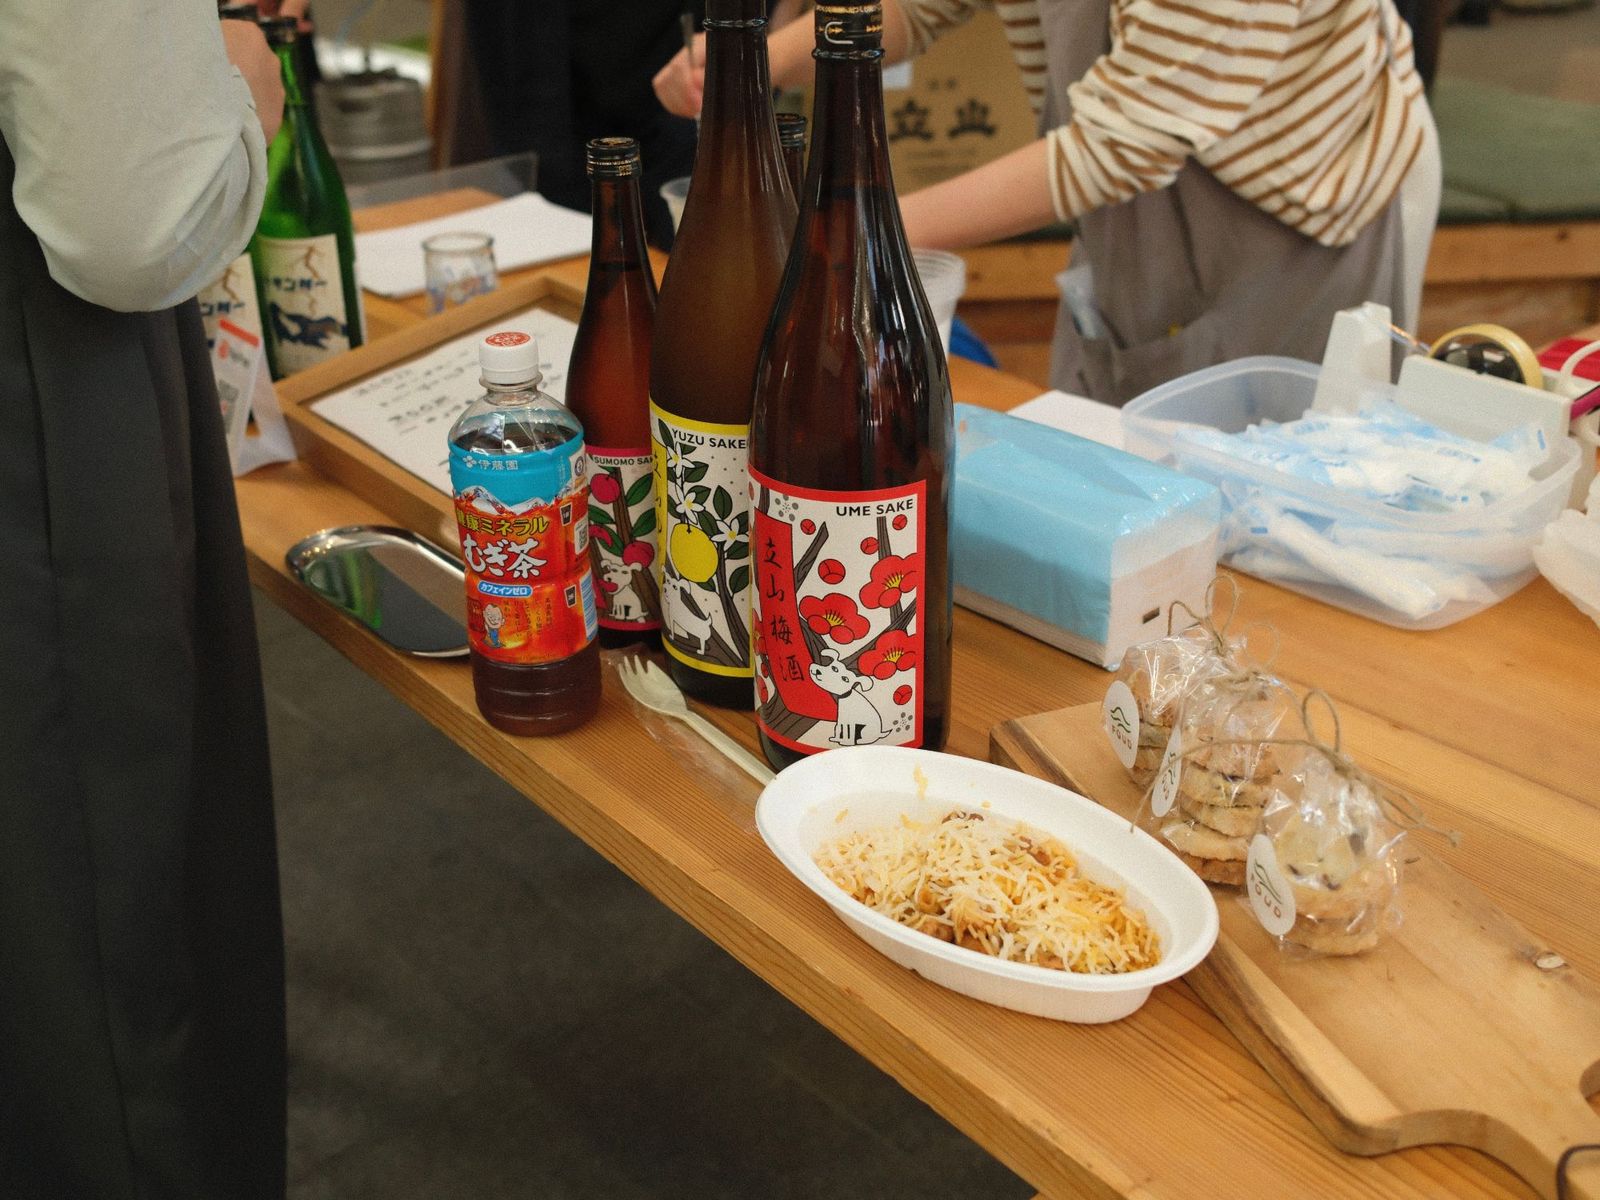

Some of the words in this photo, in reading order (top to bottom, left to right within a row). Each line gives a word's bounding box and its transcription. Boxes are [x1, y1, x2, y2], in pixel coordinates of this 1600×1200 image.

[671, 428, 705, 446] YUZU
[709, 437, 747, 449] SAKE
[478, 459, 519, 471] 伊藤園
[594, 456, 635, 465] SUMOMO
[836, 506, 871, 517] UME
[876, 498, 914, 515] SAKE
[463, 533, 548, 579] むぎ茶
[480, 583, 529, 595] カフェインゼロ
